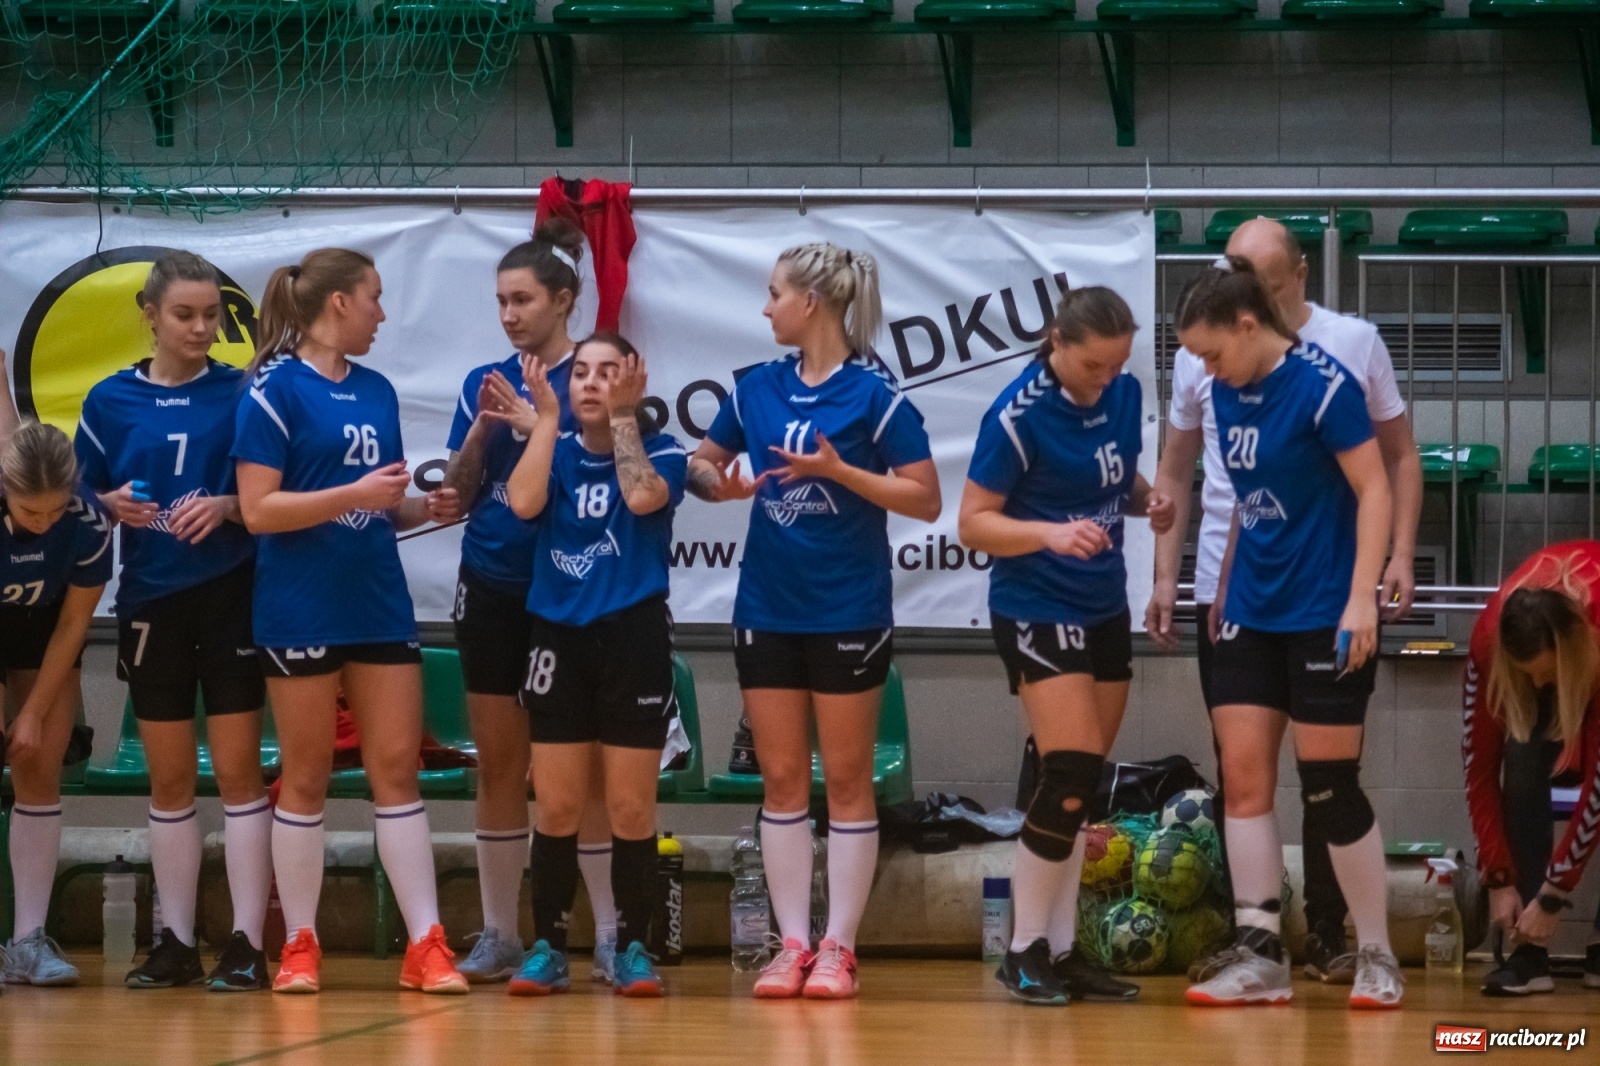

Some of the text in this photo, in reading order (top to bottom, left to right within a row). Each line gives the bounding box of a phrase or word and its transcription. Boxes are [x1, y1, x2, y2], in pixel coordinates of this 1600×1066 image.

[156, 397, 190, 407] hummel
[167, 433, 188, 476] 7
[343, 424, 380, 466] 26
[1094, 441, 1124, 488] 15
[1227, 426, 1259, 470] 20
[575, 483, 610, 518] 18
[10, 551, 44, 564] hummel
[2, 580, 45, 605] 27
[131, 622, 150, 666] 7
[525, 647, 556, 695] 18
[665, 878, 682, 952] isostar
